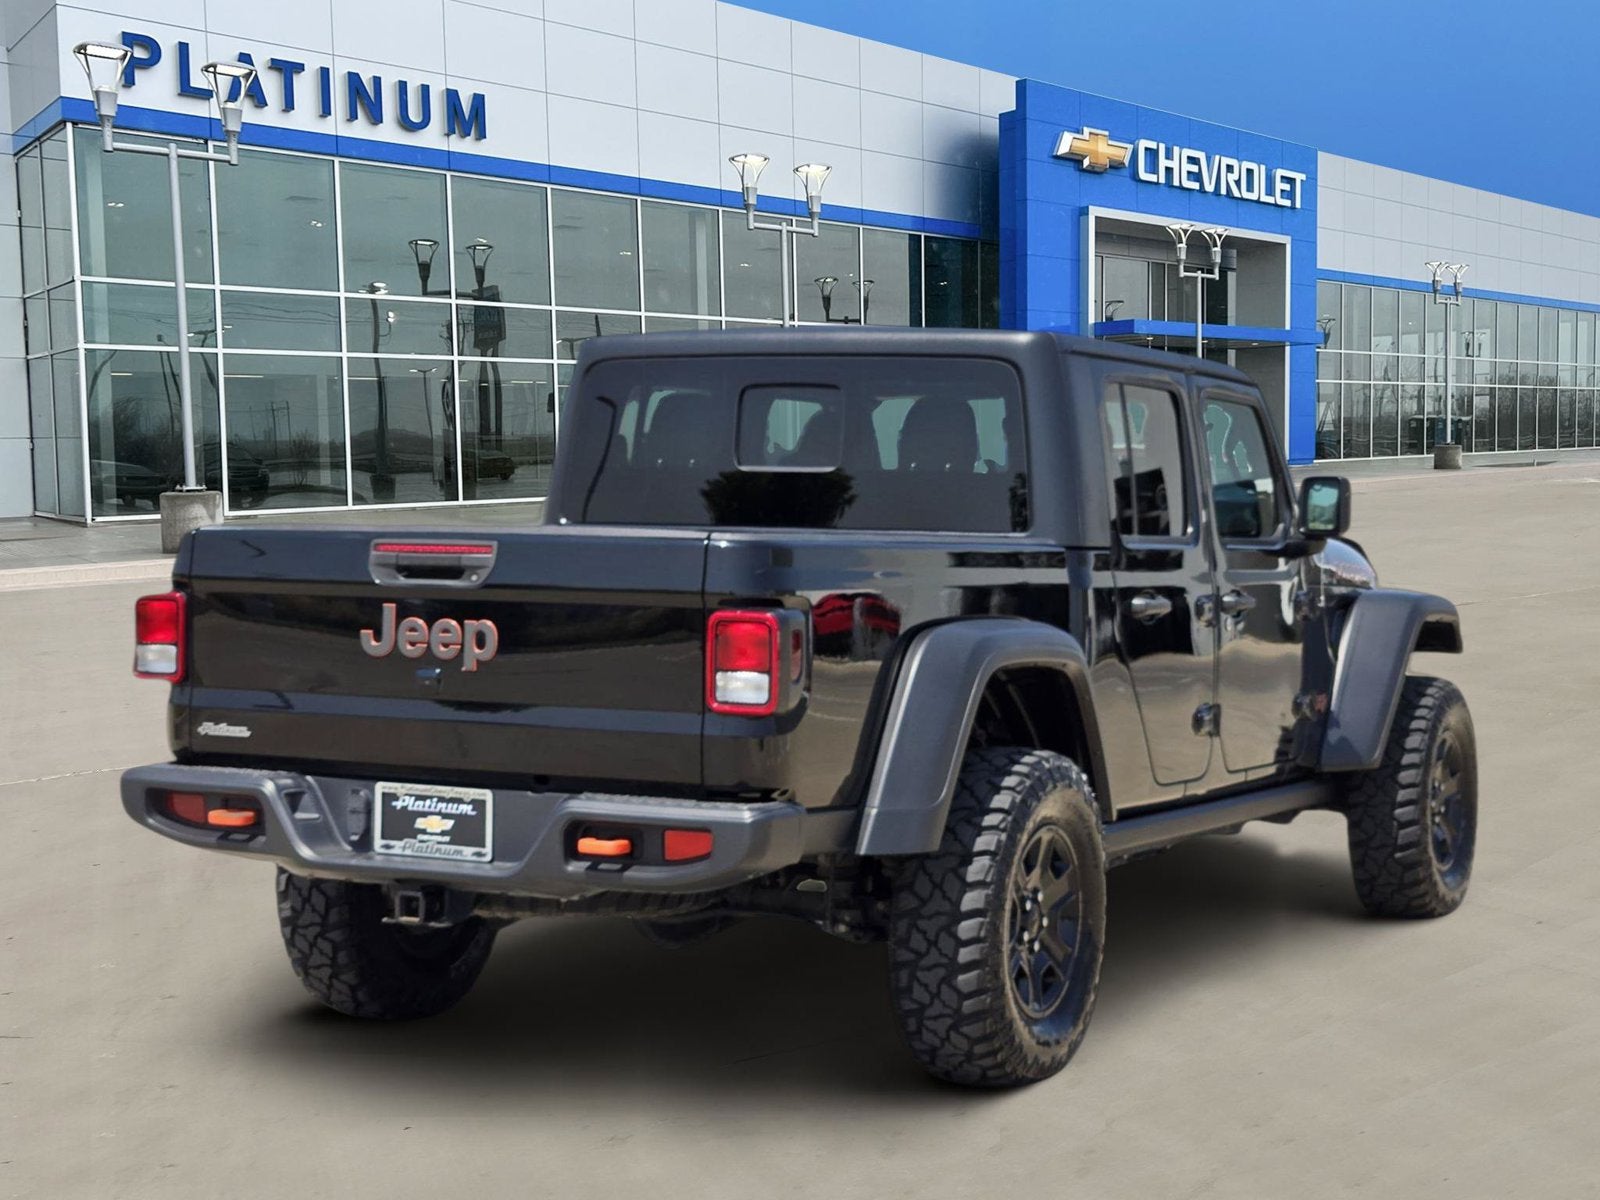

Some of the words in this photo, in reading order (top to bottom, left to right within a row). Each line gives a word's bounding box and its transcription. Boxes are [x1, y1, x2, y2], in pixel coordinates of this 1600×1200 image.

[121, 31, 487, 141] PLATINUM
[1136, 138, 1306, 208] CHEVROLET
[360, 602, 499, 672] Jeep
[391, 795, 477, 816] Platinum
[400, 840, 468, 858] Platinum
